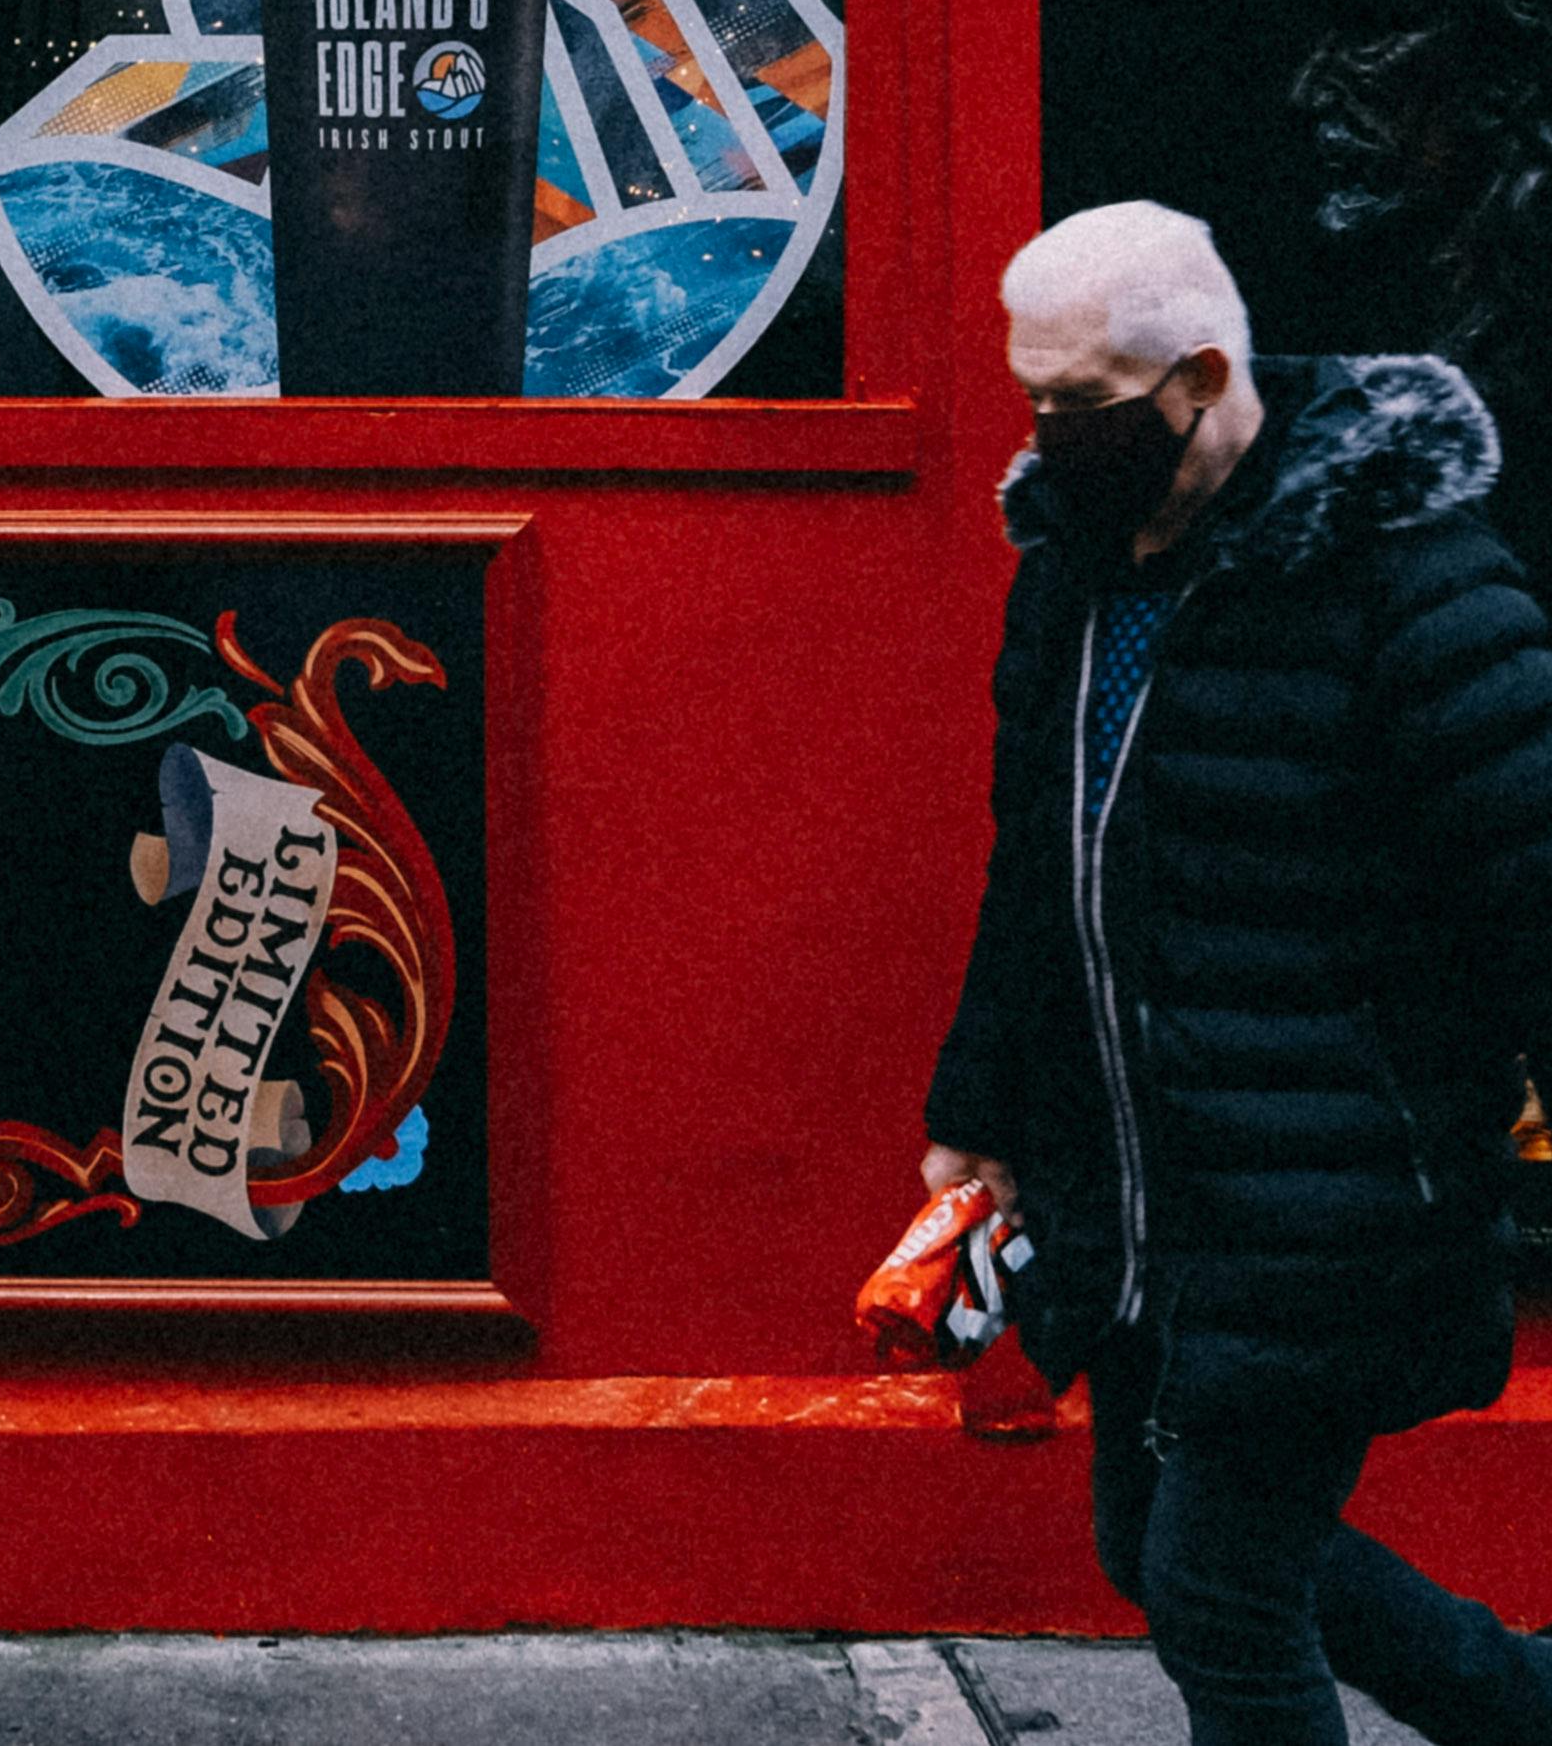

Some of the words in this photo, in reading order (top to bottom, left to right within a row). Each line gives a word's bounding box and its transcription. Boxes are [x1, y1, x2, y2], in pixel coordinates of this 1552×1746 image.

[317, 42, 405, 117] EDGE
[319, 127, 390, 150] IRISH
[409, 126, 487, 150] STOUT
[132, 847, 267, 1157] EDITION
[188, 826, 325, 1176] LIMITED
